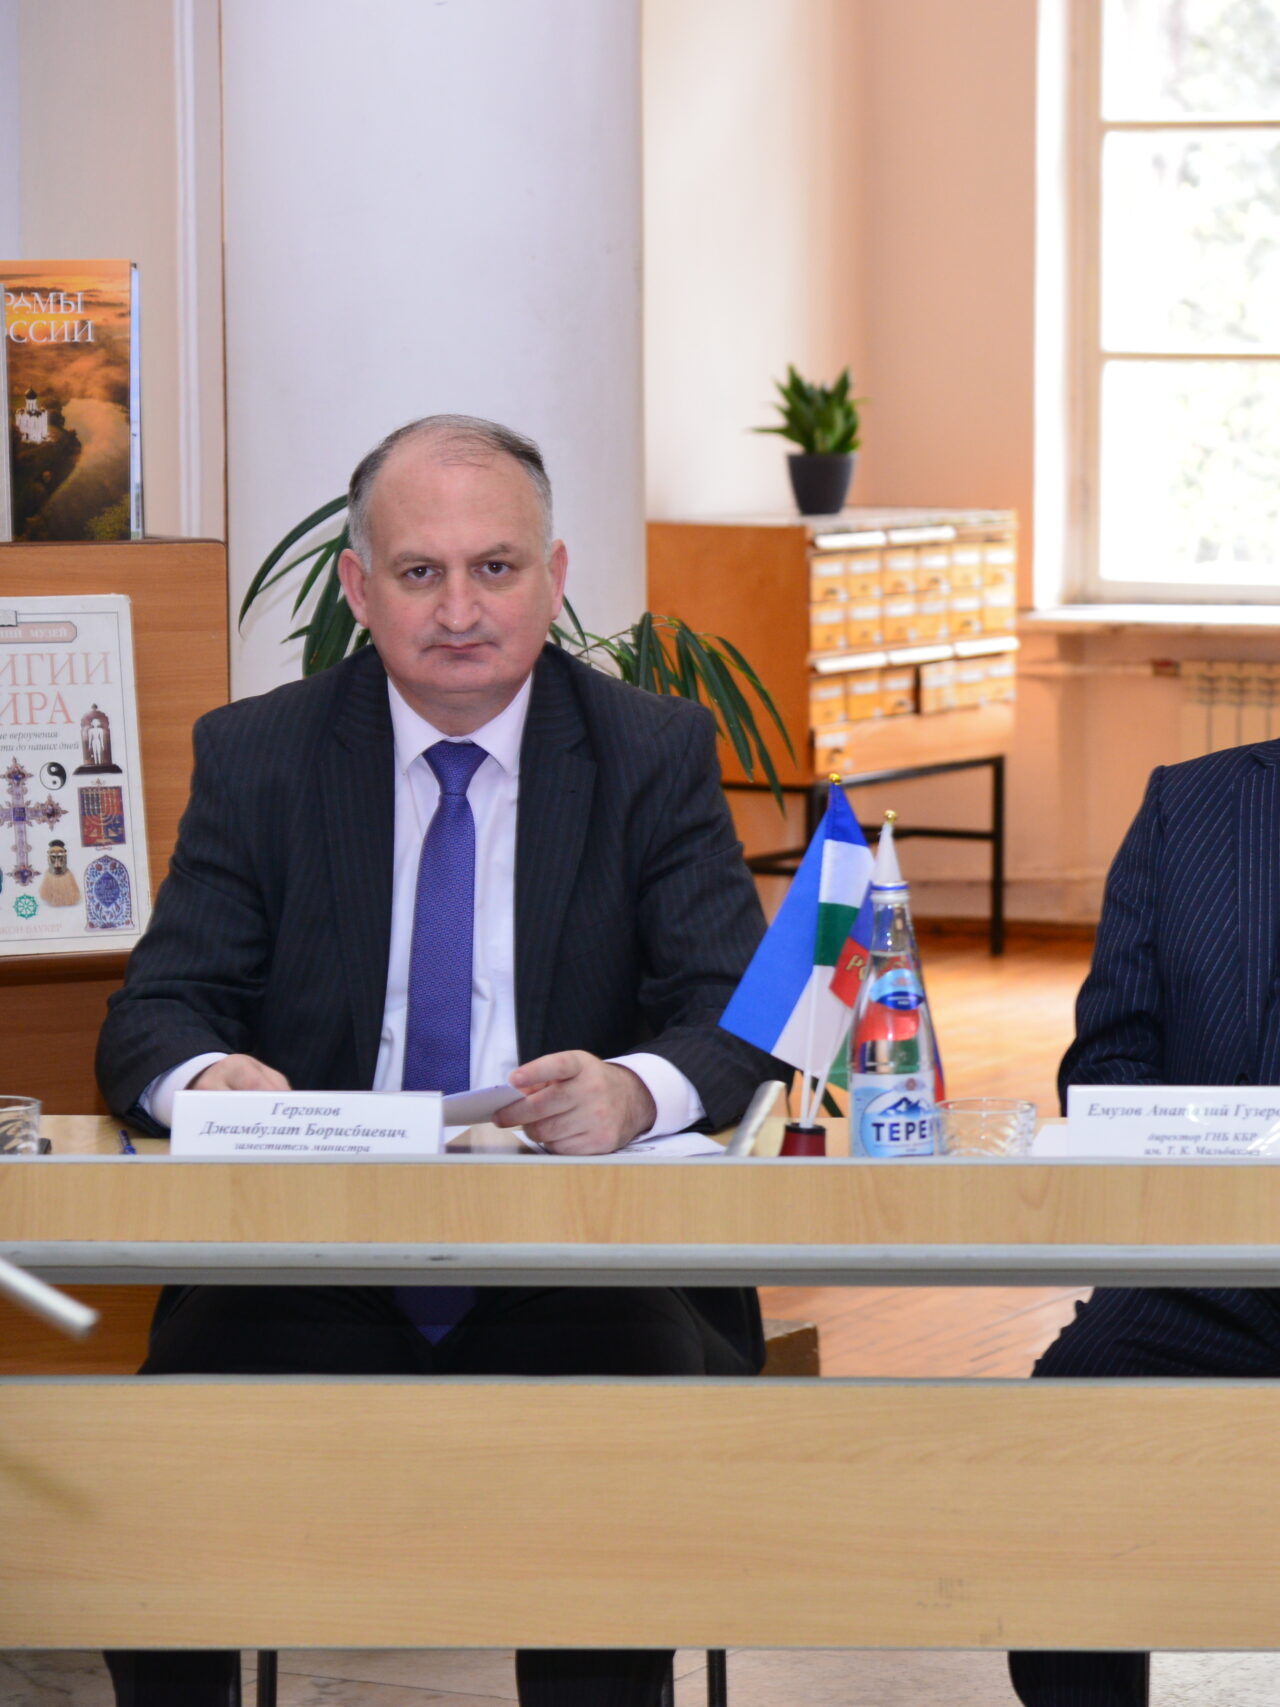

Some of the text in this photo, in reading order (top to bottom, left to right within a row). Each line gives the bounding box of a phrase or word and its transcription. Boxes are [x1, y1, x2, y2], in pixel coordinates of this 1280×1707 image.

[4, 320, 94, 343] ССИИ
[271, 1102, 341, 1119] Гергоков
[1088, 1103, 1142, 1119] Емузов
[198, 1121, 408, 1139] Джамбулат Борисбиевич
[1147, 1132, 1202, 1143] директор
[233, 1142, 371, 1155] заместитель министра
